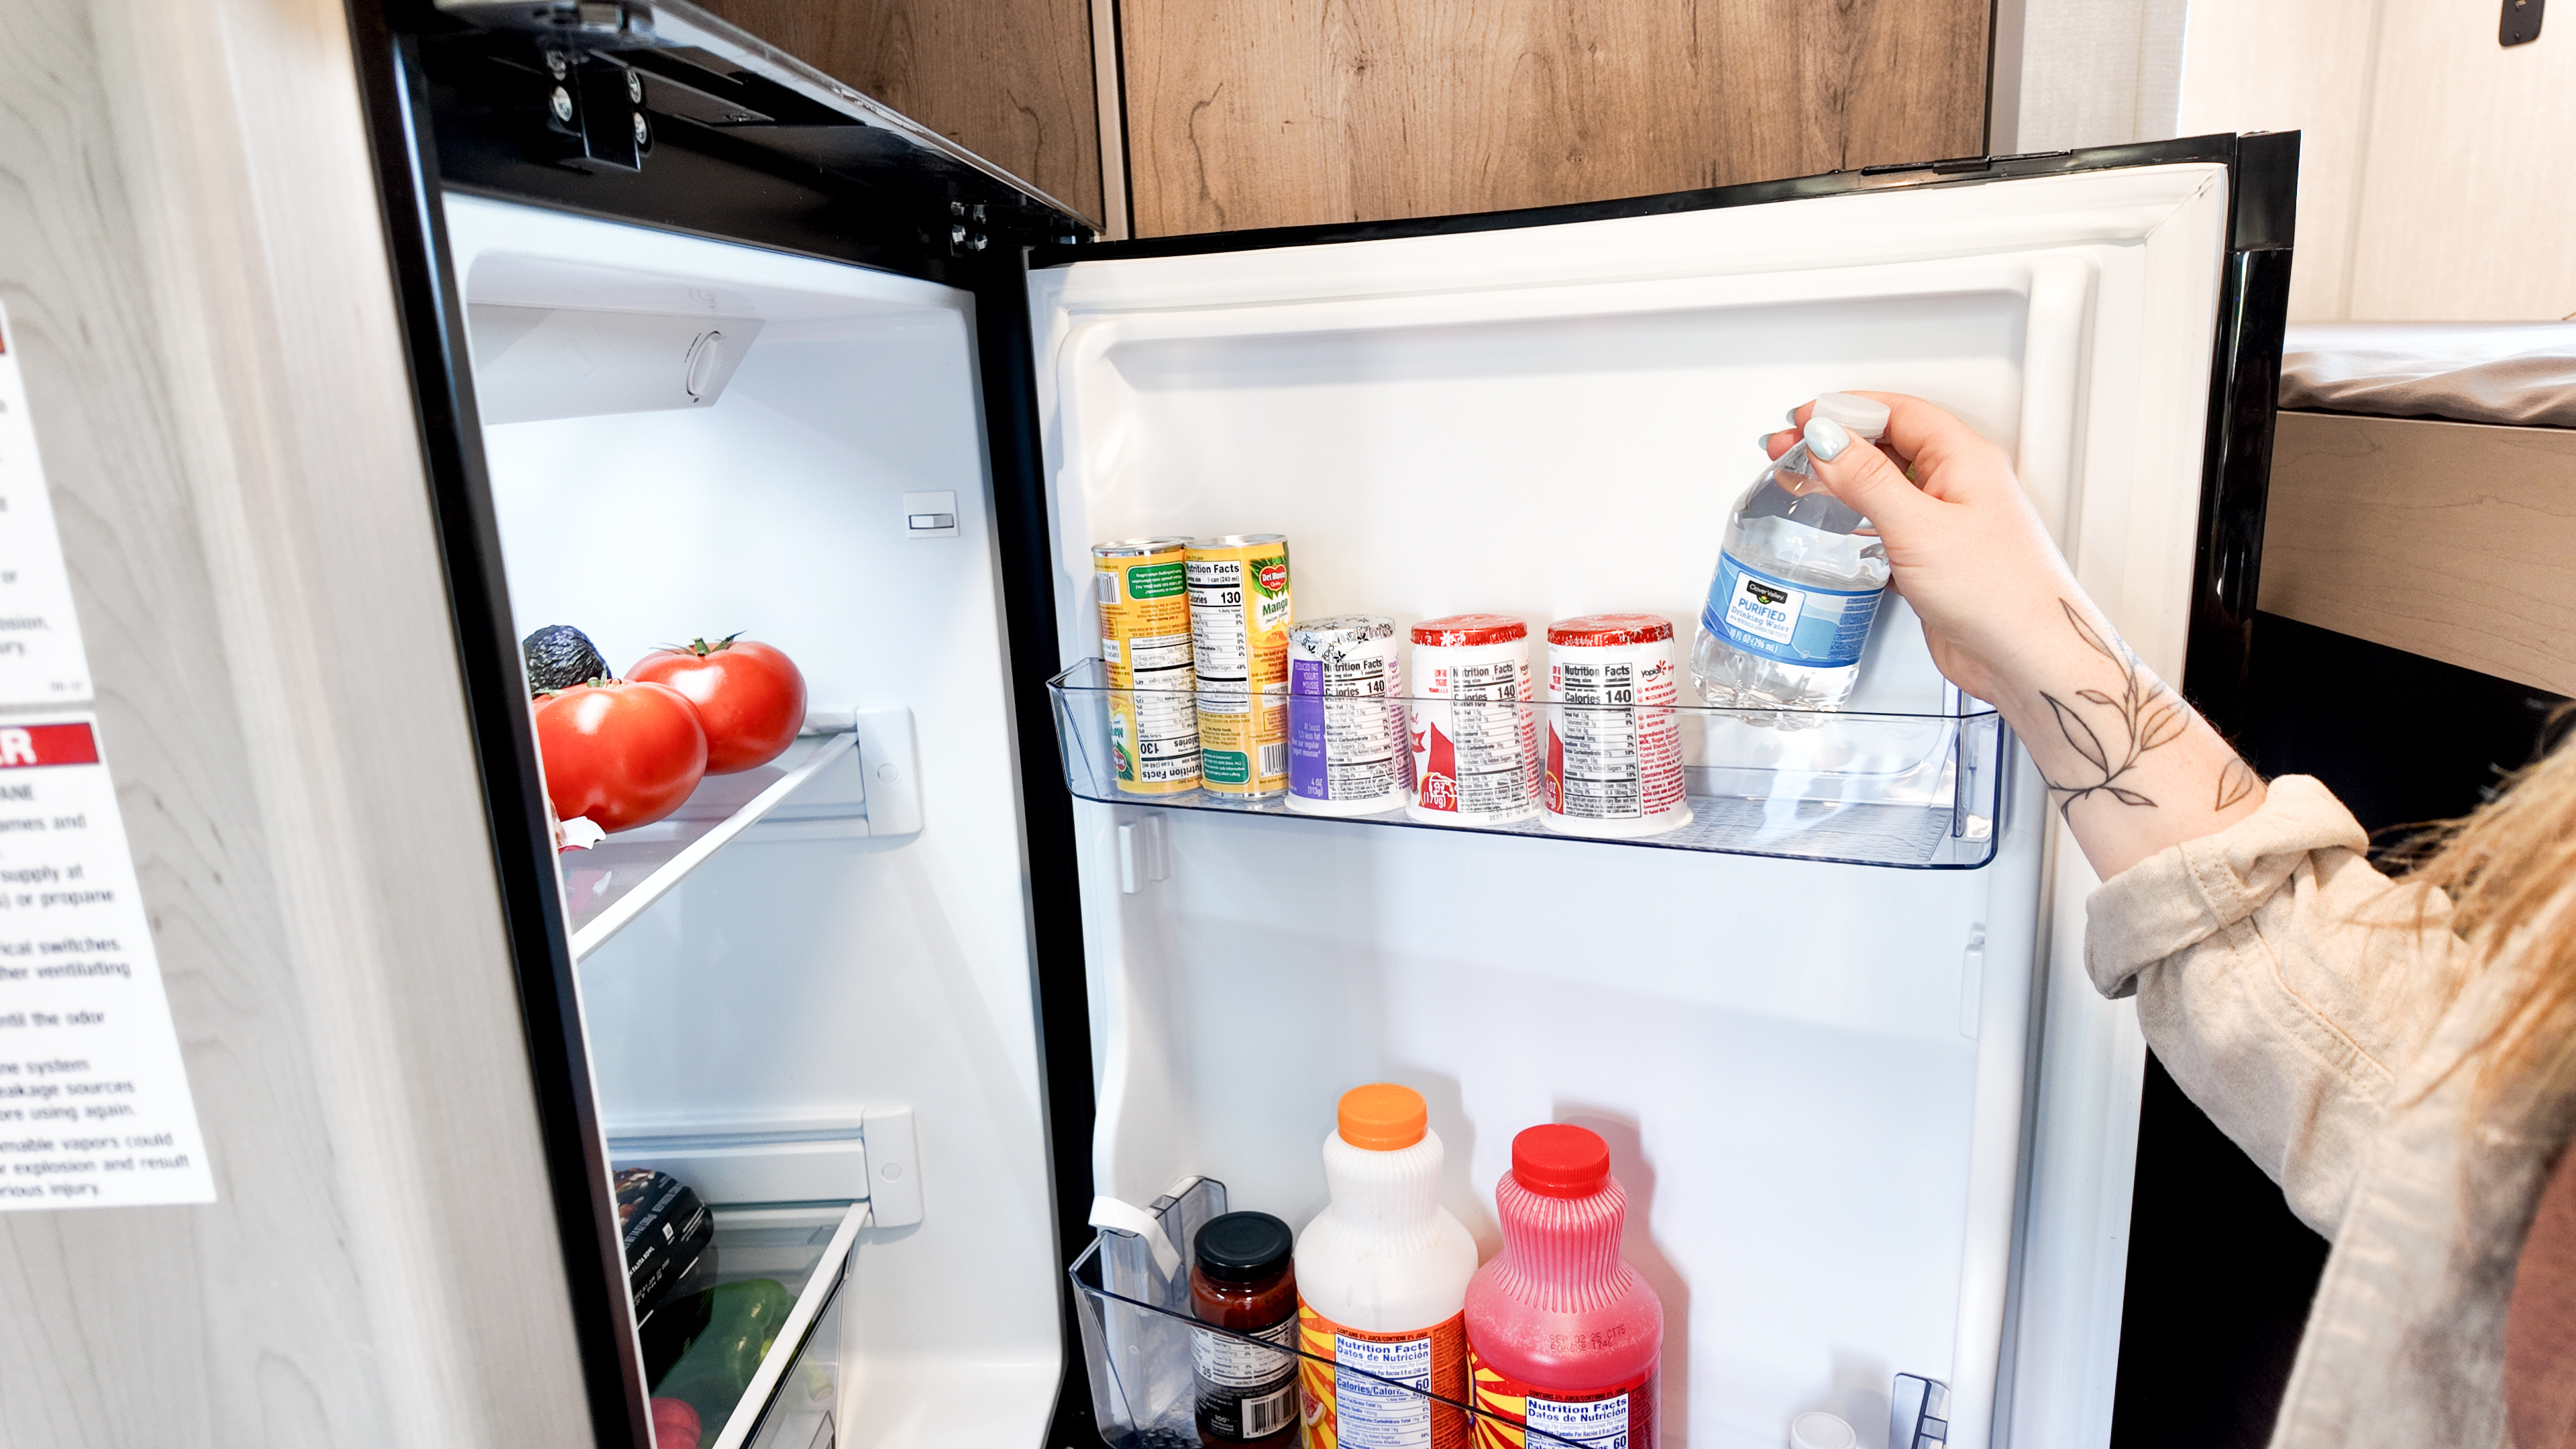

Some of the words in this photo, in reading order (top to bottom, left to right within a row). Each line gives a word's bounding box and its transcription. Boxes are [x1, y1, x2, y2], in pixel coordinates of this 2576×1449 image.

[1214, 564, 1240, 573] Facts
[1221, 591, 1241, 604] 130
[1263, 598, 1288, 616] Mango
[1738, 598, 1786, 622] PURIFIED
[1731, 606, 1764, 626] Drinking
[1766, 620, 1789, 633] Water
[1736, 631, 1742, 641] FL
[1364, 659, 1382, 669] Facts
[1453, 668, 1489, 678] Ntrition
[1495, 663, 1513, 674] Facts
[1564, 665, 1600, 676] Nutrition
[1605, 665, 1629, 676] Facts
[1326, 688, 1359, 696] Clories
[1367, 680, 1385, 694] 140
[1498, 685, 1515, 698] 140
[1565, 692, 1601, 704] Calories
[1605, 690, 1631, 703] 140
[1309, 724, 1320, 732] least
[1639, 731, 1664, 740] Ingredients:
[0, 729, 37, 765] R
[1140, 743, 1159, 754] 130
[1305, 742, 1320, 750] regular
[1574, 748, 1601, 757] Carbohydrate
[1142, 771, 1167, 779] Facts
[1316, 778, 1322, 786] OZ
[1549, 781, 1556, 794] OZ
[1337, 1328, 1358, 1338] CONTAINS
[1590, 1332, 1602, 1342] 25
[1337, 1337, 1390, 1354] Nutrition
[1395, 1342, 1428, 1353] Facts
[1337, 1345, 1363, 1359] Datos
[1367, 1353, 1379, 1362] de
[1383, 1350, 1428, 1362] Nutrición
[1415, 1378, 1429, 1391] 60
[1528, 1399, 1588, 1413] Nutrition
[1593, 1398, 1627, 1412] Facts
[1528, 1409, 1559, 1421] Datos
[1563, 1414, 1576, 1422] de
[1580, 1407, 1626, 1422] Nutrición
[1532, 1419, 1550, 1429] Servings
[1587, 1421, 1605, 1430] Raciones
[1613, 1435, 1626, 1449] 60
